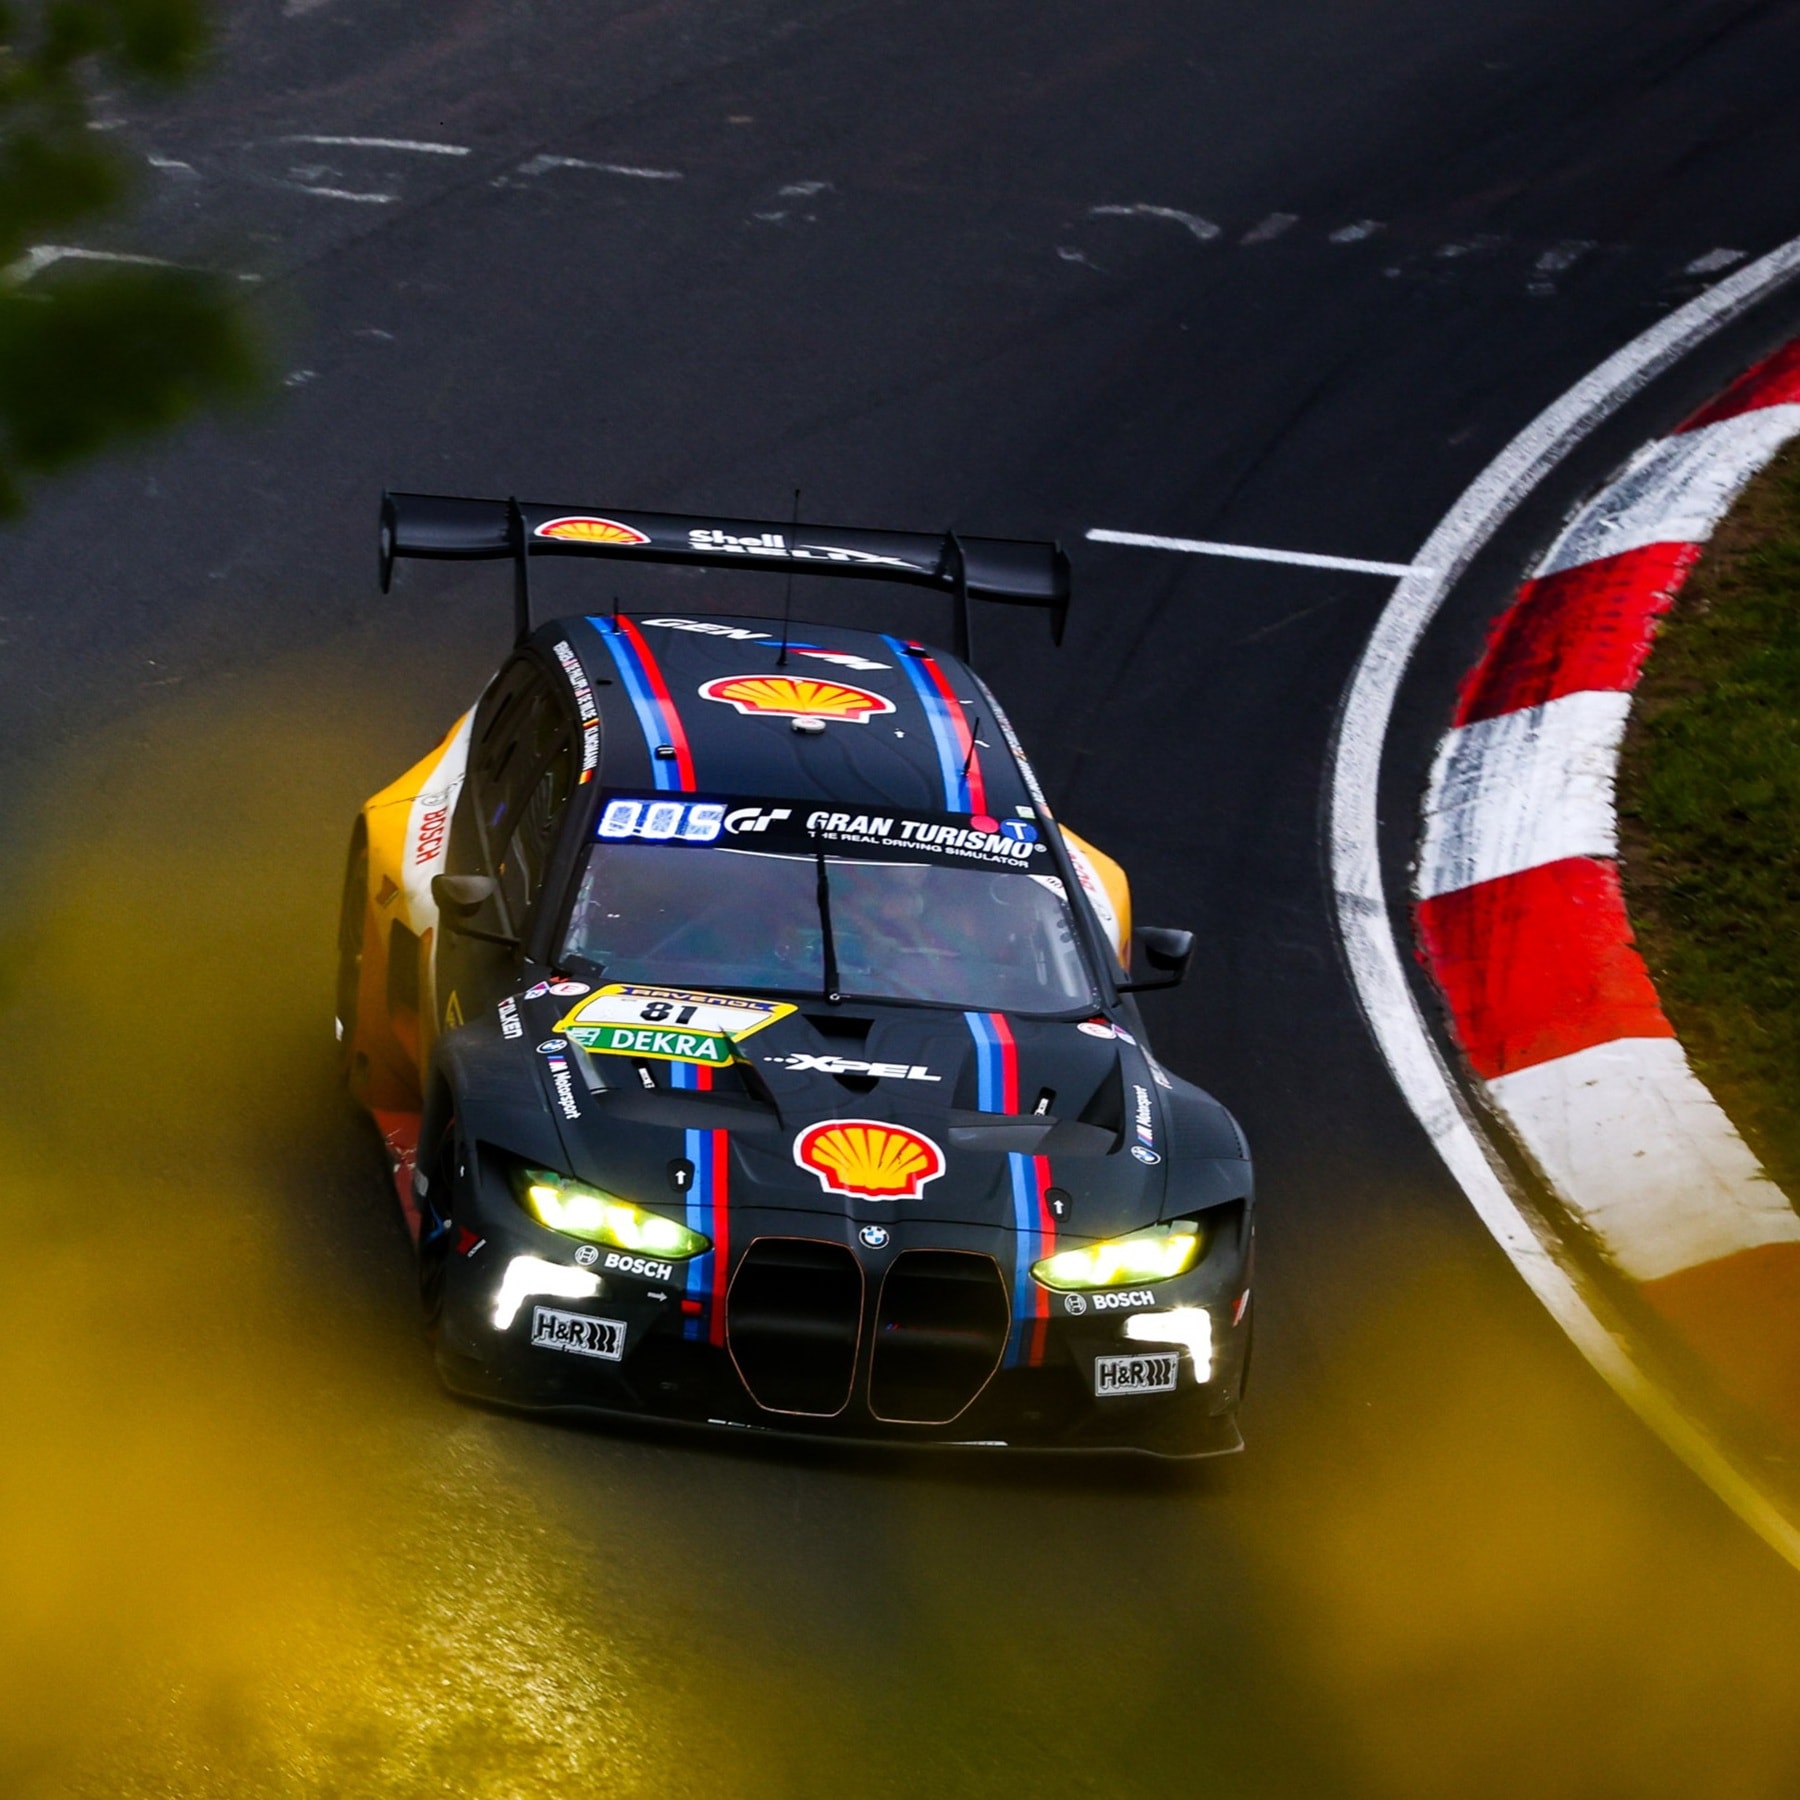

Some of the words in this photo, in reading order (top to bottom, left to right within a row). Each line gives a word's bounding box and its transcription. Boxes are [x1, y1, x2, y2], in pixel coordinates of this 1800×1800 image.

[688, 529, 785, 548] Shell
[641, 618, 773, 640] GEN
[415, 806, 448, 865] BOSCH
[806, 811, 894, 836] GRAN
[841, 833, 880, 844] REAL
[882, 838, 942, 852] DRIVING
[945, 847, 1029, 868] SIMULATOR
[497, 997, 523, 1039] FALKEN
[639, 1001, 698, 1025] 81
[610, 1029, 719, 1060] DEKRA
[785, 1053, 942, 1082] XPEL
[553, 1070, 582, 1119] Motorsport
[604, 1253, 673, 1281] BOSCH
[1092, 1290, 1155, 1310] BOSCH
[537, 1313, 586, 1346] H&R
[1101, 1361, 1143, 1387] H&R
